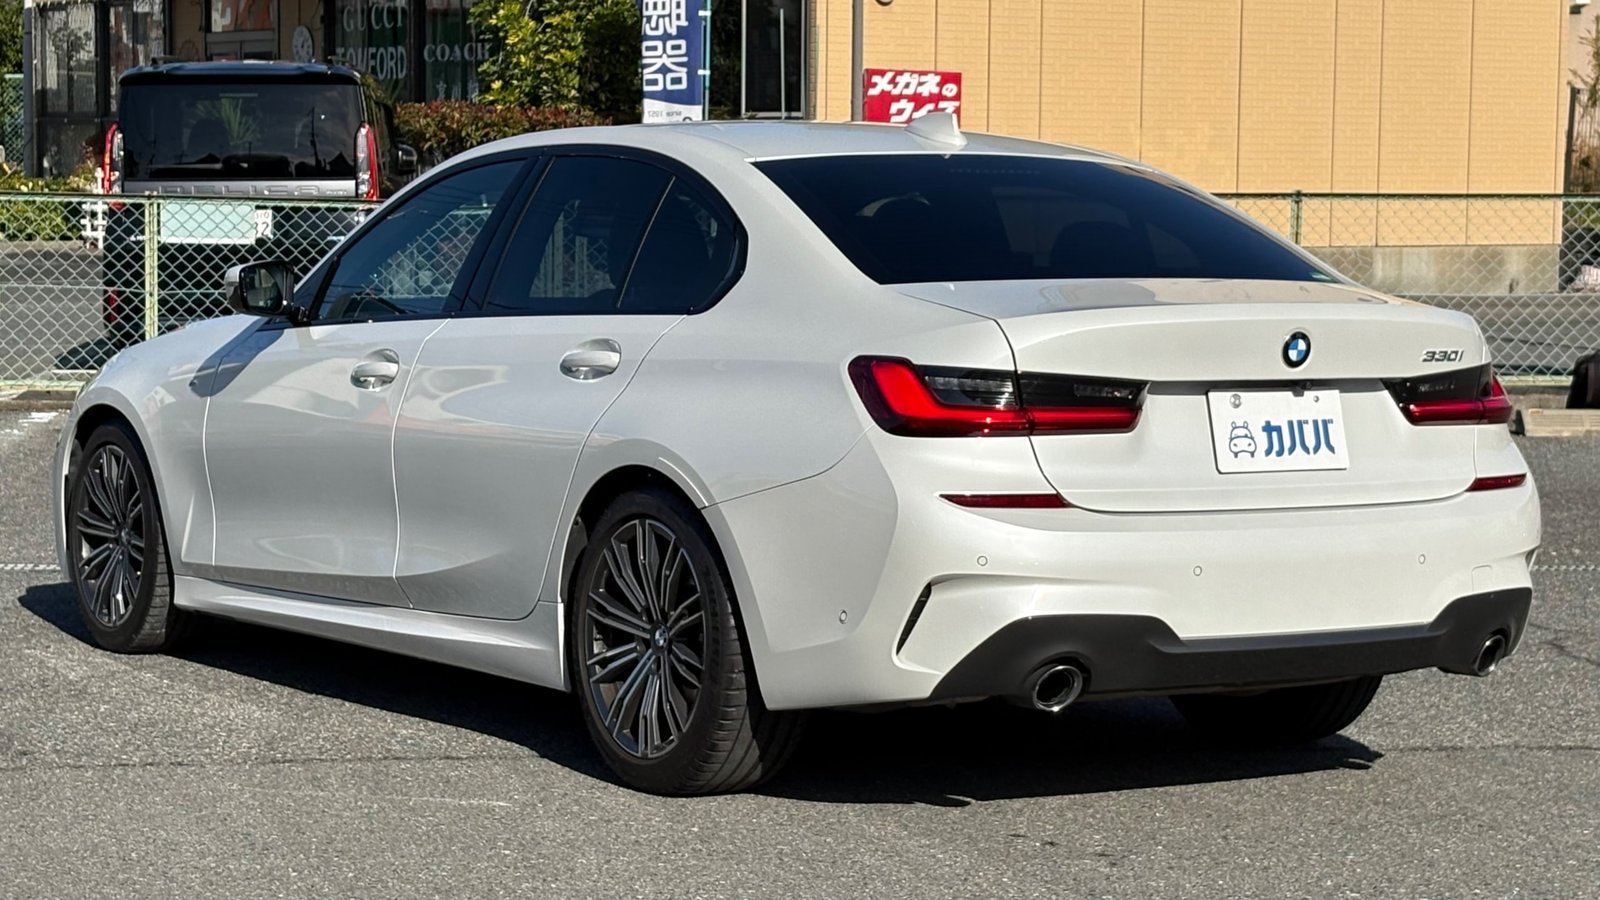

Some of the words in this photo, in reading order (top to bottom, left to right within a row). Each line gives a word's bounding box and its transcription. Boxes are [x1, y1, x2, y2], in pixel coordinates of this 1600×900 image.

[342, 2, 404, 32] GUCCI
[423, 42, 491, 63] COACH
[867, 71, 959, 98] メガネの
[1422, 350, 1464, 363] 330i
[1261, 418, 1336, 458] カババ
